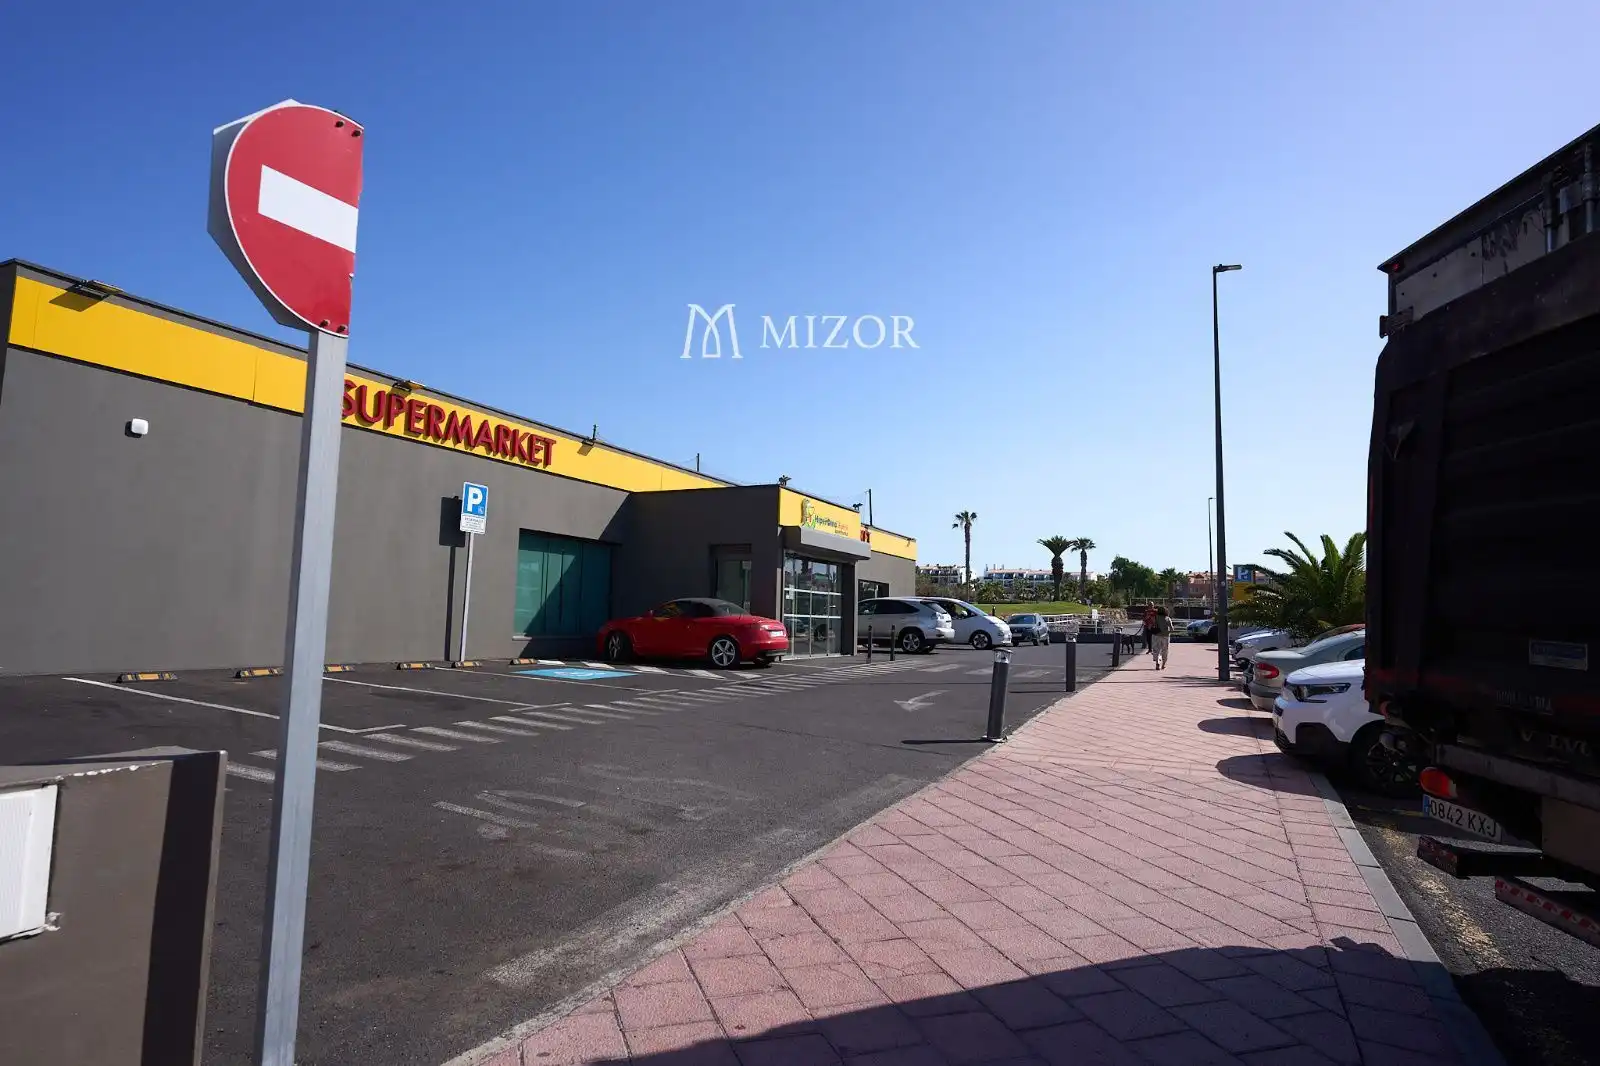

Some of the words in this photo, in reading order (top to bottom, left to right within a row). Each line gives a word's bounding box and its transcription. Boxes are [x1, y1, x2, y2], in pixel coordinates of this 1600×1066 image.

[341, 379, 557, 468] SUPERMARKET
[466, 486, 483, 512] P
[1430, 800, 1464, 827] 0842
